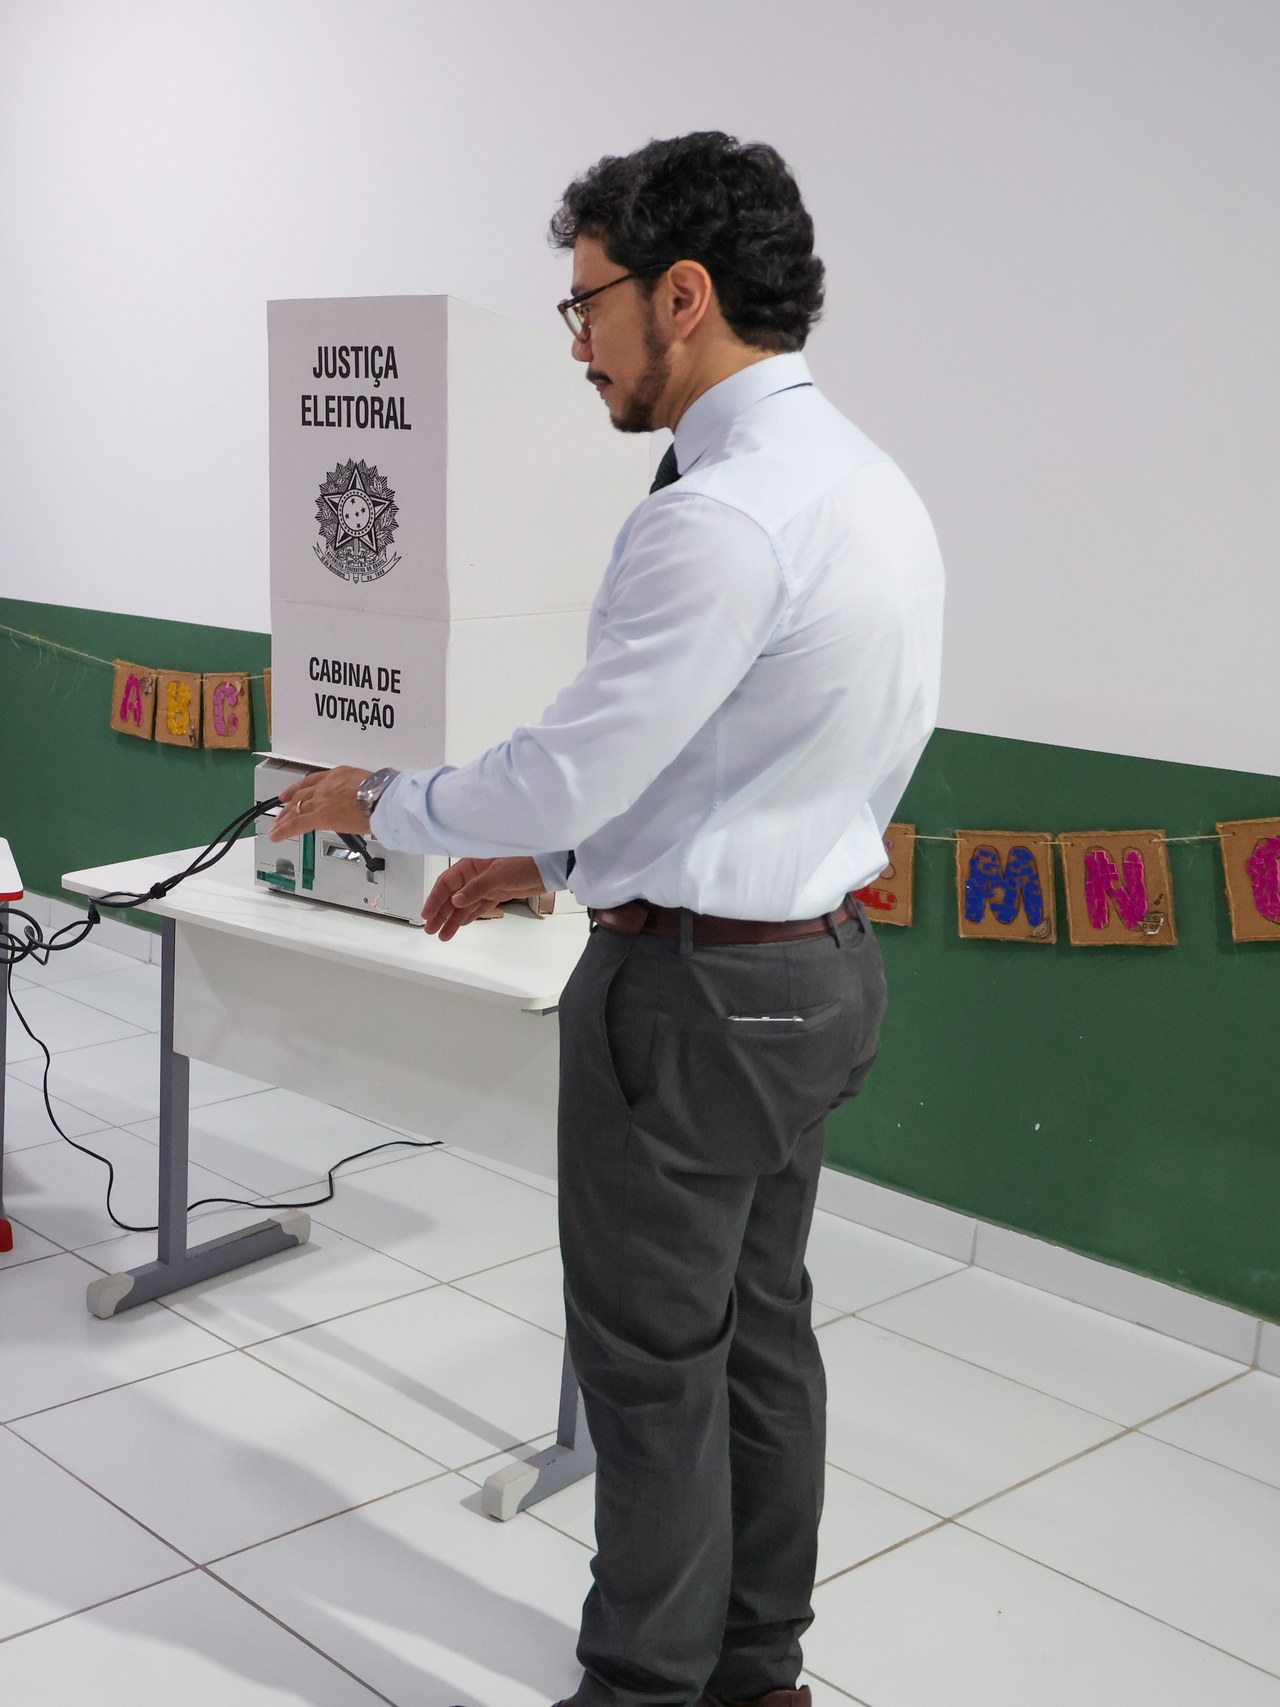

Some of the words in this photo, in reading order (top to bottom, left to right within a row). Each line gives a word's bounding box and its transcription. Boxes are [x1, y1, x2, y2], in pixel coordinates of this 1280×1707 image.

[312, 345, 399, 388] JUSTIÇA
[301, 394, 412, 431] ELEITORAL
[309, 656, 373, 690] CABINA
[377, 666, 402, 695] DE
[120, 673, 143, 727] A
[166, 681, 191, 736] B
[214, 682, 239, 737] C
[313, 692, 396, 731] VOTAÇÃO
[1083, 847, 1147, 931] N
